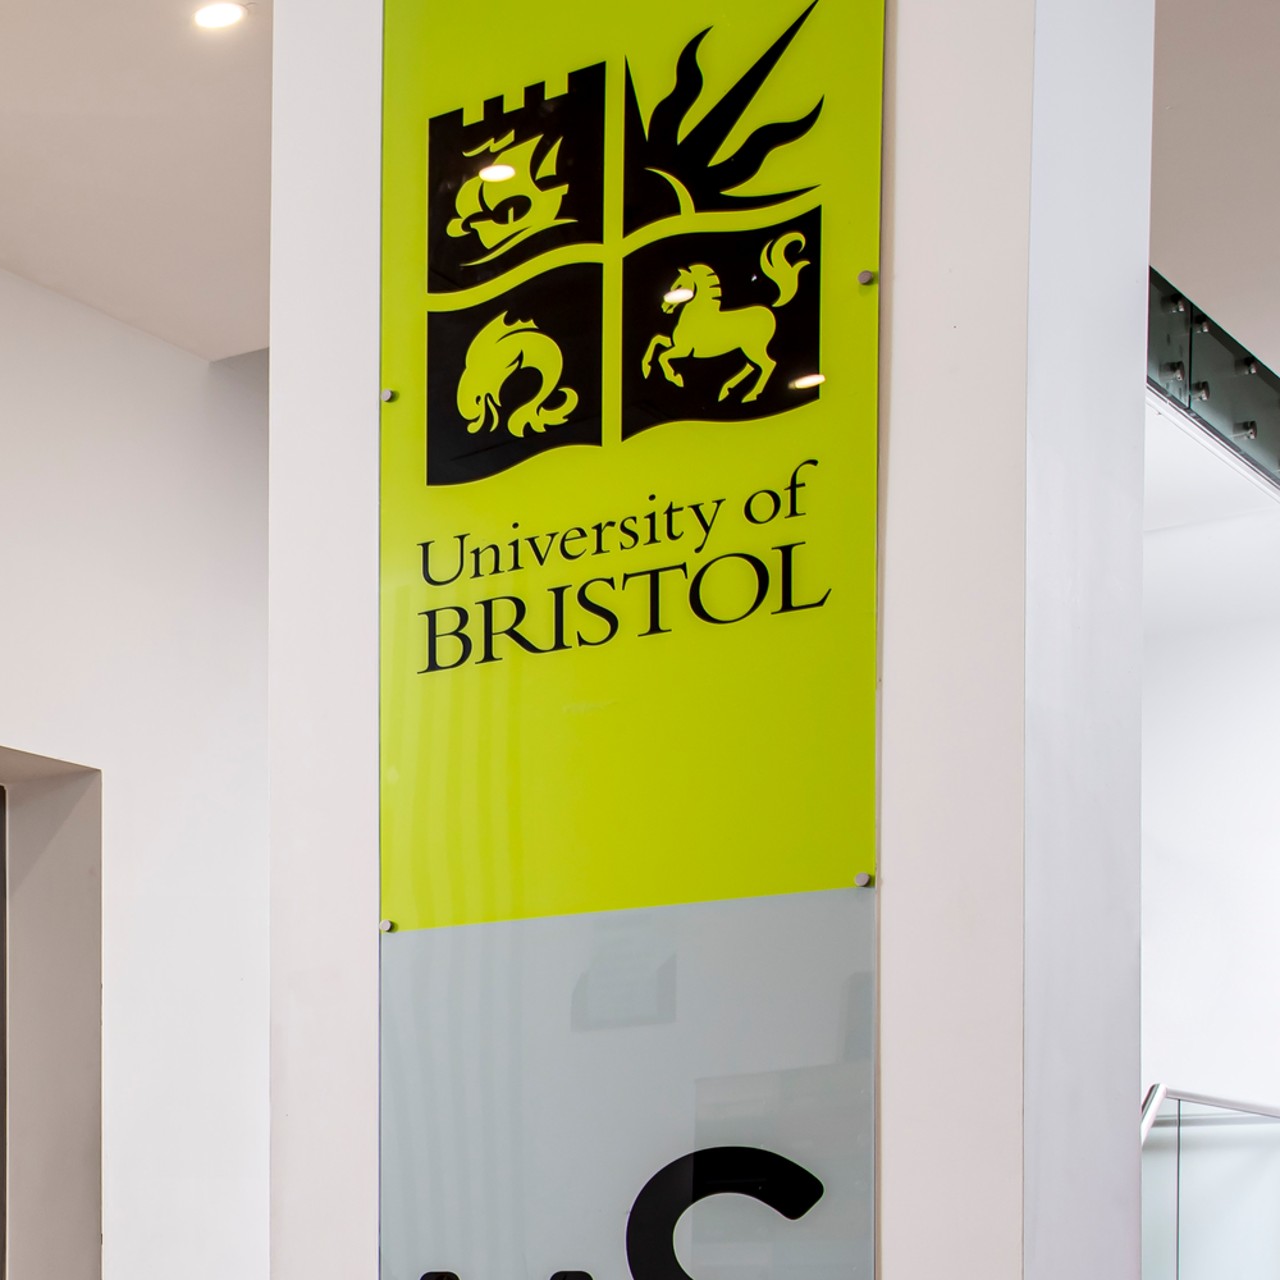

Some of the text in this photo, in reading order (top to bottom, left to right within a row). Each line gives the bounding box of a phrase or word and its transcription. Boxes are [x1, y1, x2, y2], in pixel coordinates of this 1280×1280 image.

[416, 459, 819, 587] University of
[416, 541, 832, 675] BRISTOL
